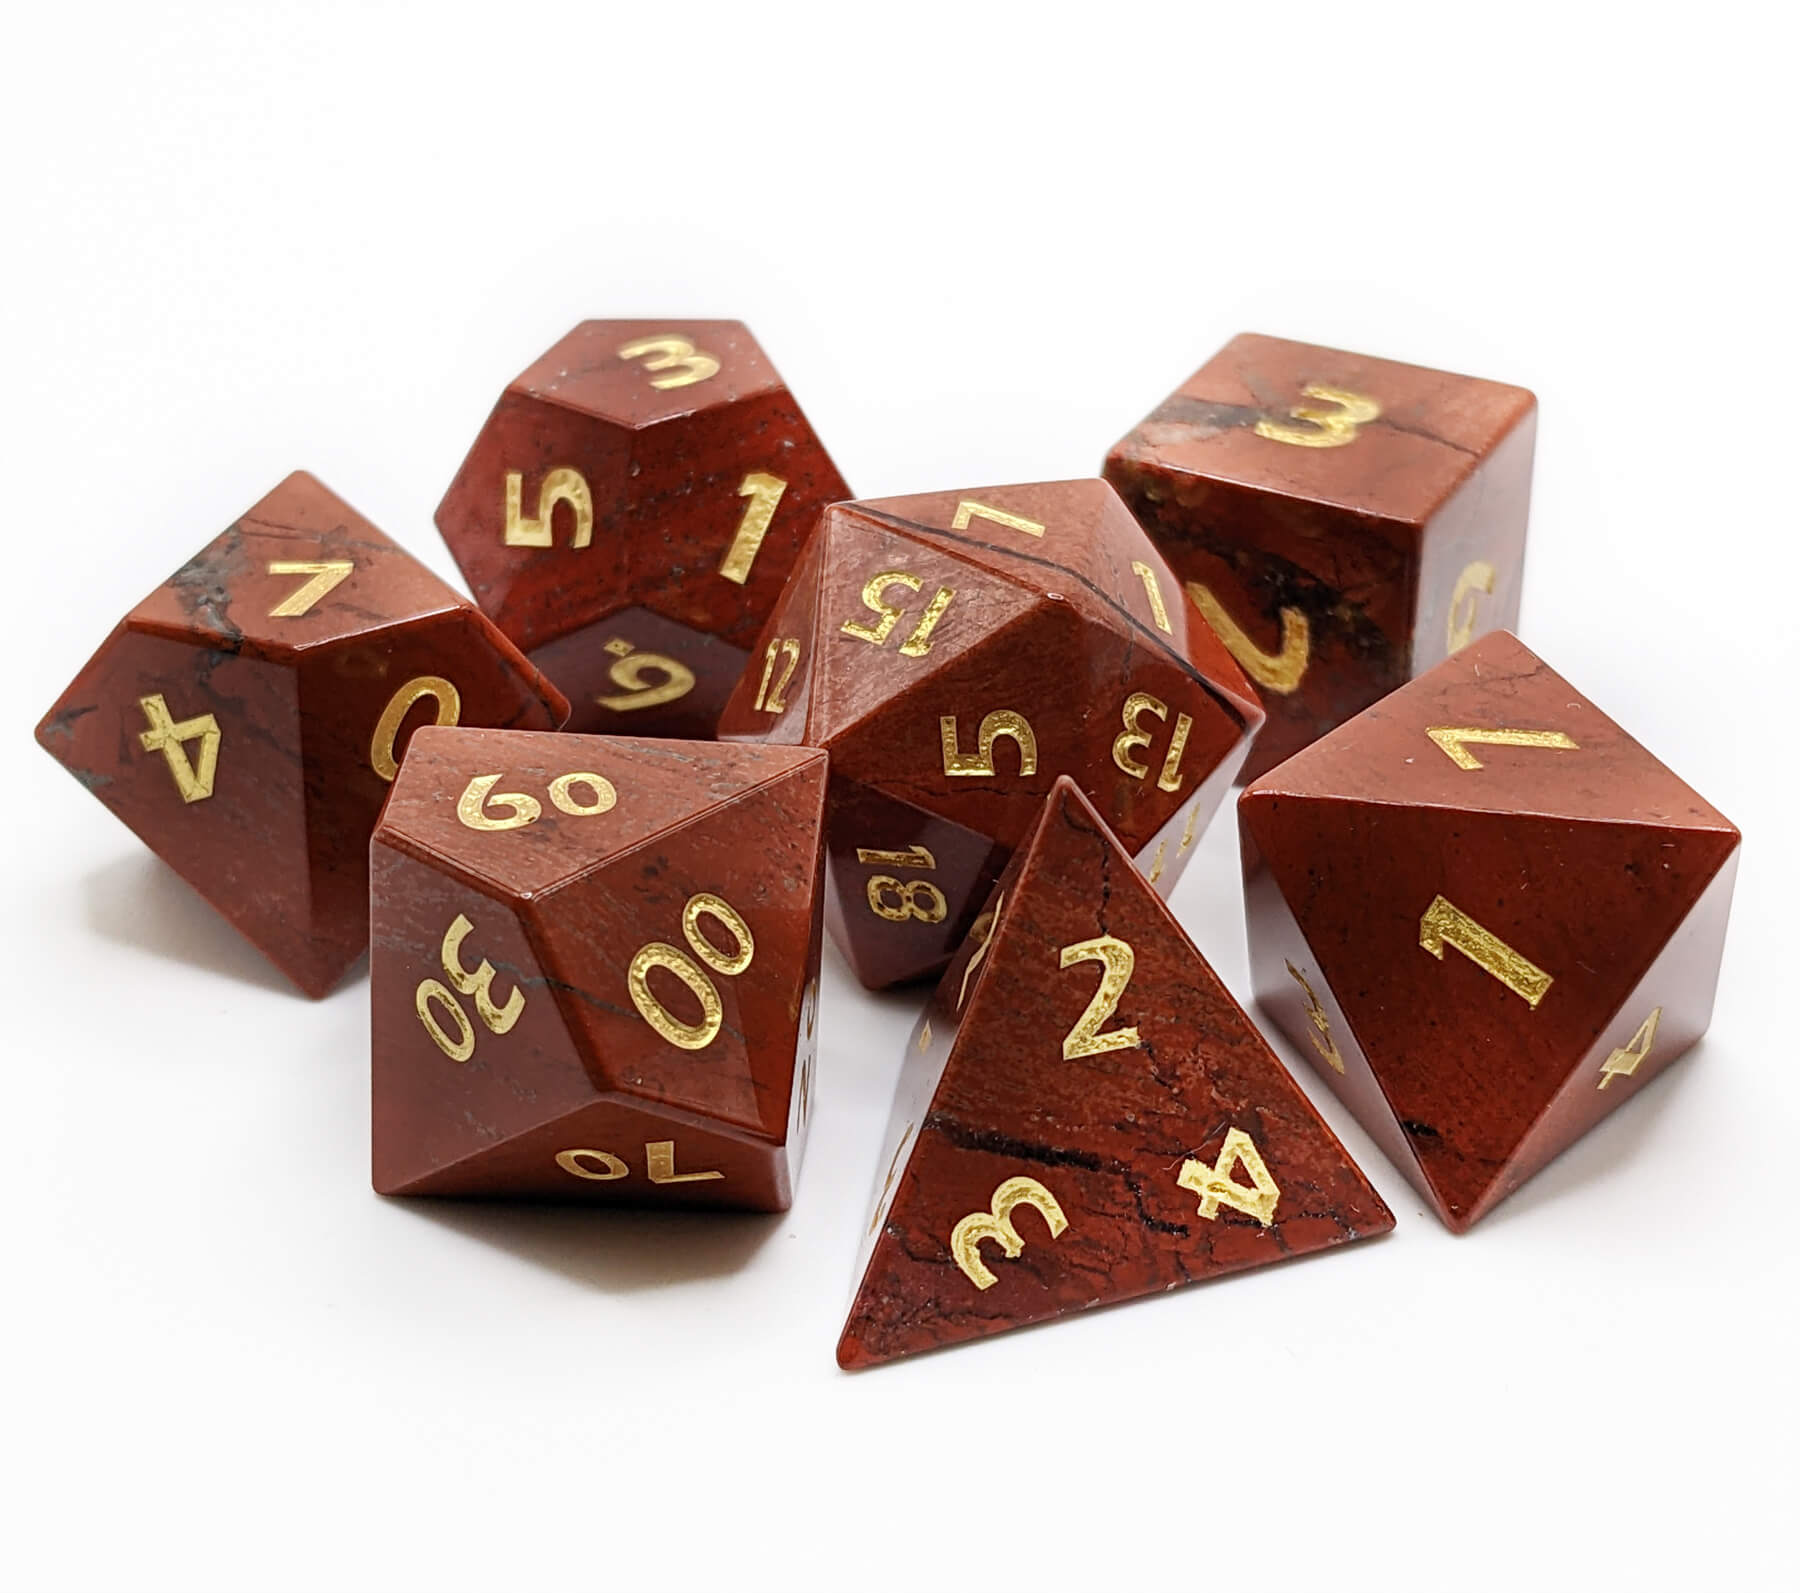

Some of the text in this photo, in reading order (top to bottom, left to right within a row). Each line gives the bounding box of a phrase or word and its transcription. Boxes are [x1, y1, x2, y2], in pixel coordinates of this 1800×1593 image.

[618, 333, 721, 390] 3
[1254, 382, 1382, 449] 3
[504, 467, 594, 549] 5
[719, 471, 788, 586] 1
[840, 569, 957, 658] 15
[754, 638, 801, 713] 12
[139, 693, 222, 804] 4
[370, 675, 461, 783] 0
[939, 709, 1038, 777] 5
[1111, 691, 1194, 793] 13
[456, 771, 618, 831] 60
[856, 844, 948, 924] 18
[415, 913, 526, 1063] 30
[627, 892, 755, 1051] 00
[1060, 933, 1142, 1061] 2
[1418, 893, 1555, 1012] 1
[1596, 1006, 1663, 1090] 4
[555, 1140, 726, 1185] 70
[1176, 1126, 1281, 1228] 4
[949, 1175, 1069, 1291] 3
